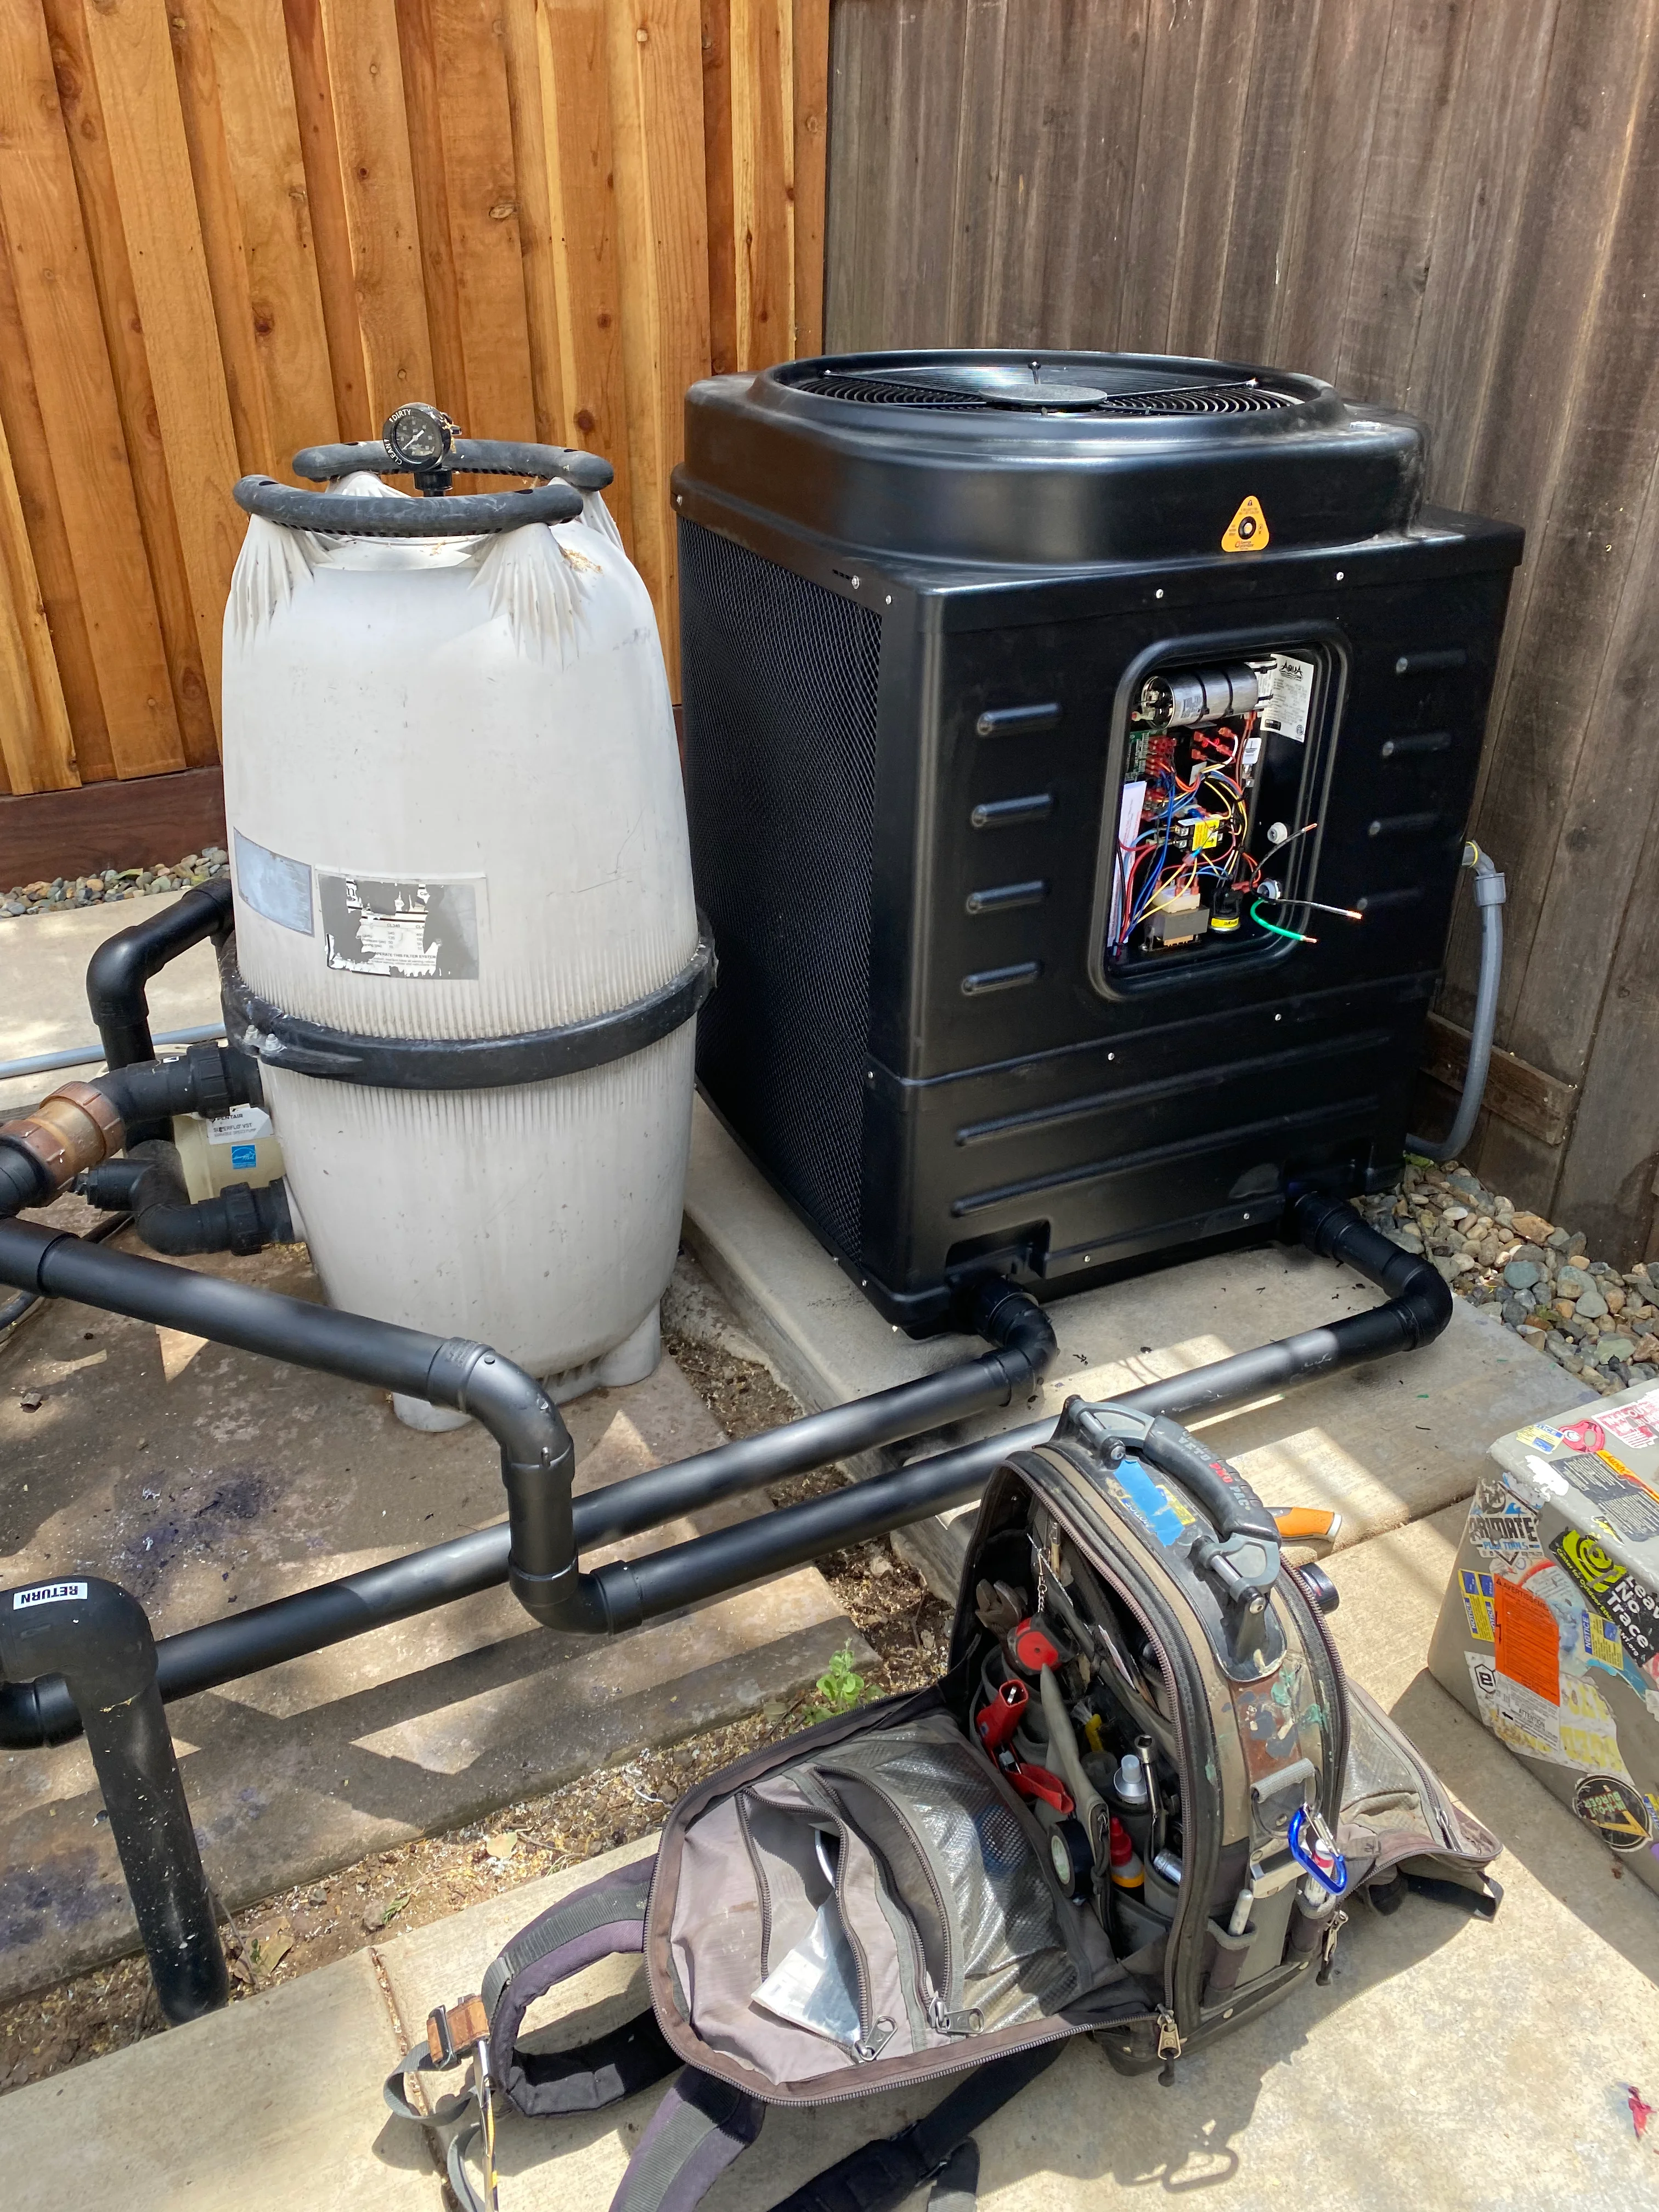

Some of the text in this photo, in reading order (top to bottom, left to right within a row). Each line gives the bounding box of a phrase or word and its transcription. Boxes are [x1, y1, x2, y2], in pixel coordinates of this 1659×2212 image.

[393, 409, 411, 422] DIRTY
[385, 443, 403, 466] CLEAN
[1178, 1436, 1211, 1462] VETO
[1229, 1486, 1249, 1507] PAC
[21, 1585, 78, 1604] RETURN
[1626, 1575, 1659, 1619] Leav
[1465, 1602, 1477, 1629] NOTICE
[1486, 1606, 1496, 1633] OTICE
[1607, 1590, 1649, 1649] Trace
[1583, 1616, 1593, 1649] NOTICE
[1519, 1708, 1545, 1728] ATTENTION
[1583, 1790, 1622, 1808] BURGER
